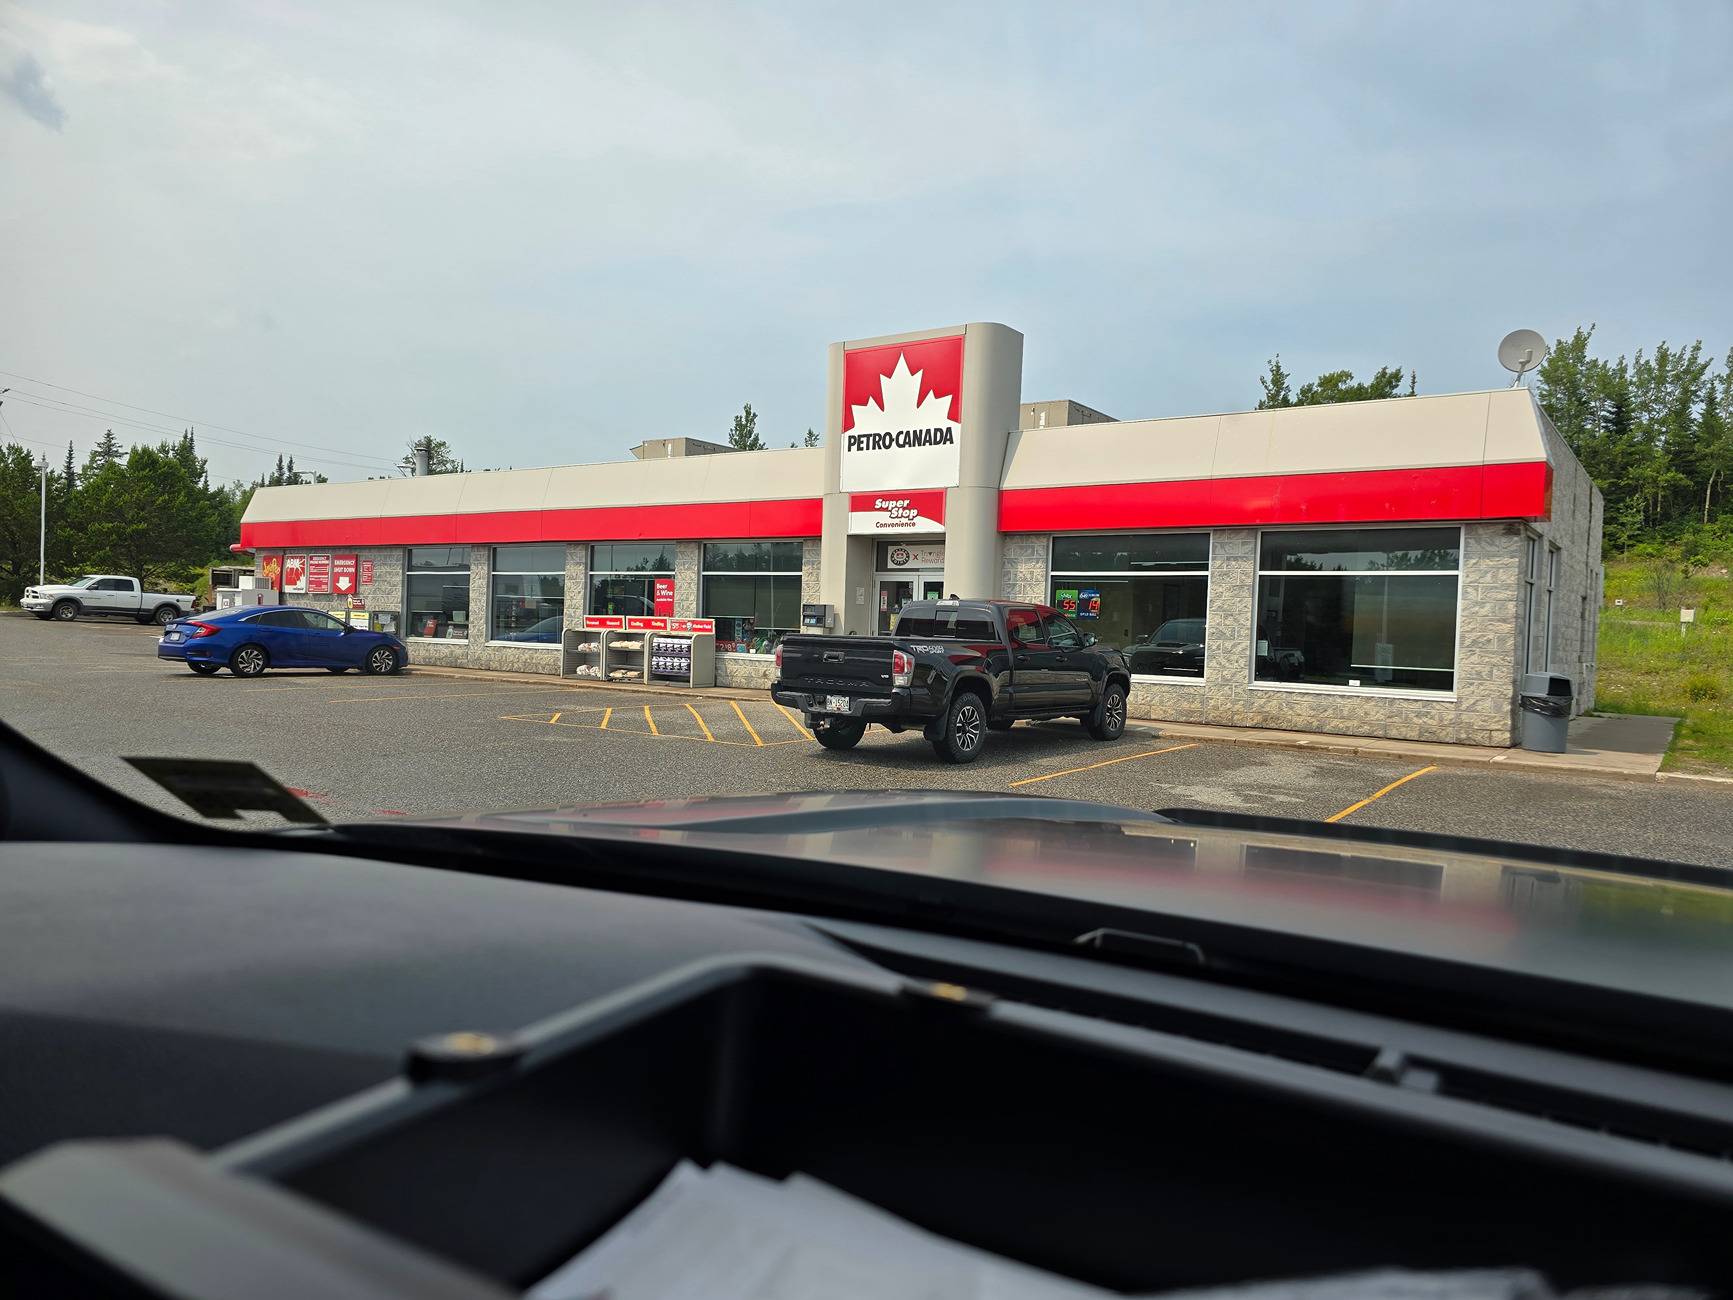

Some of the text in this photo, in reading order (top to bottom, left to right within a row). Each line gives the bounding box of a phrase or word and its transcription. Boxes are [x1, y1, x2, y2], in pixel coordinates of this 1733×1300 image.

[874, 498, 911, 511] Super
[889, 507, 919, 520] Stop
[875, 520, 916, 528] Convenience
[910, 645, 928, 654] TRD
[804, 677, 869, 687] TACOMA
